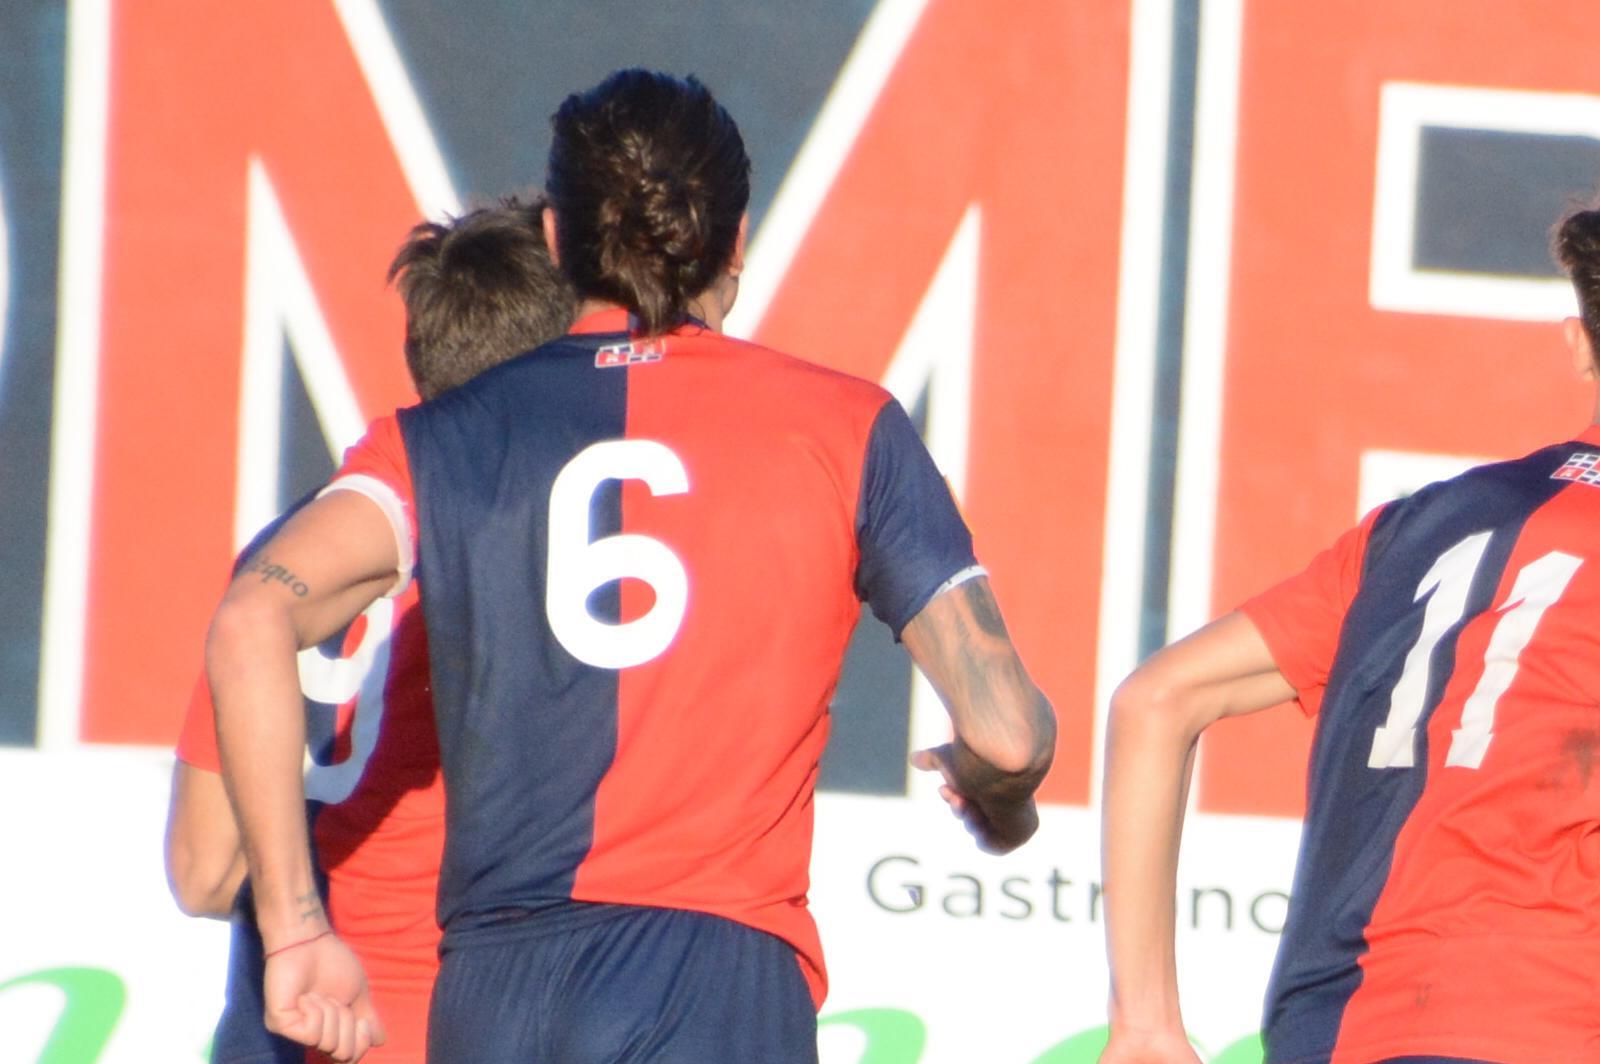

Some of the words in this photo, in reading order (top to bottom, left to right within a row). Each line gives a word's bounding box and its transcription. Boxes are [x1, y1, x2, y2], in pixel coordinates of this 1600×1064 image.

[546, 440, 690, 669] 6
[1367, 530, 1584, 769] 11
[866, 855, 1293, 934] Gastrno
